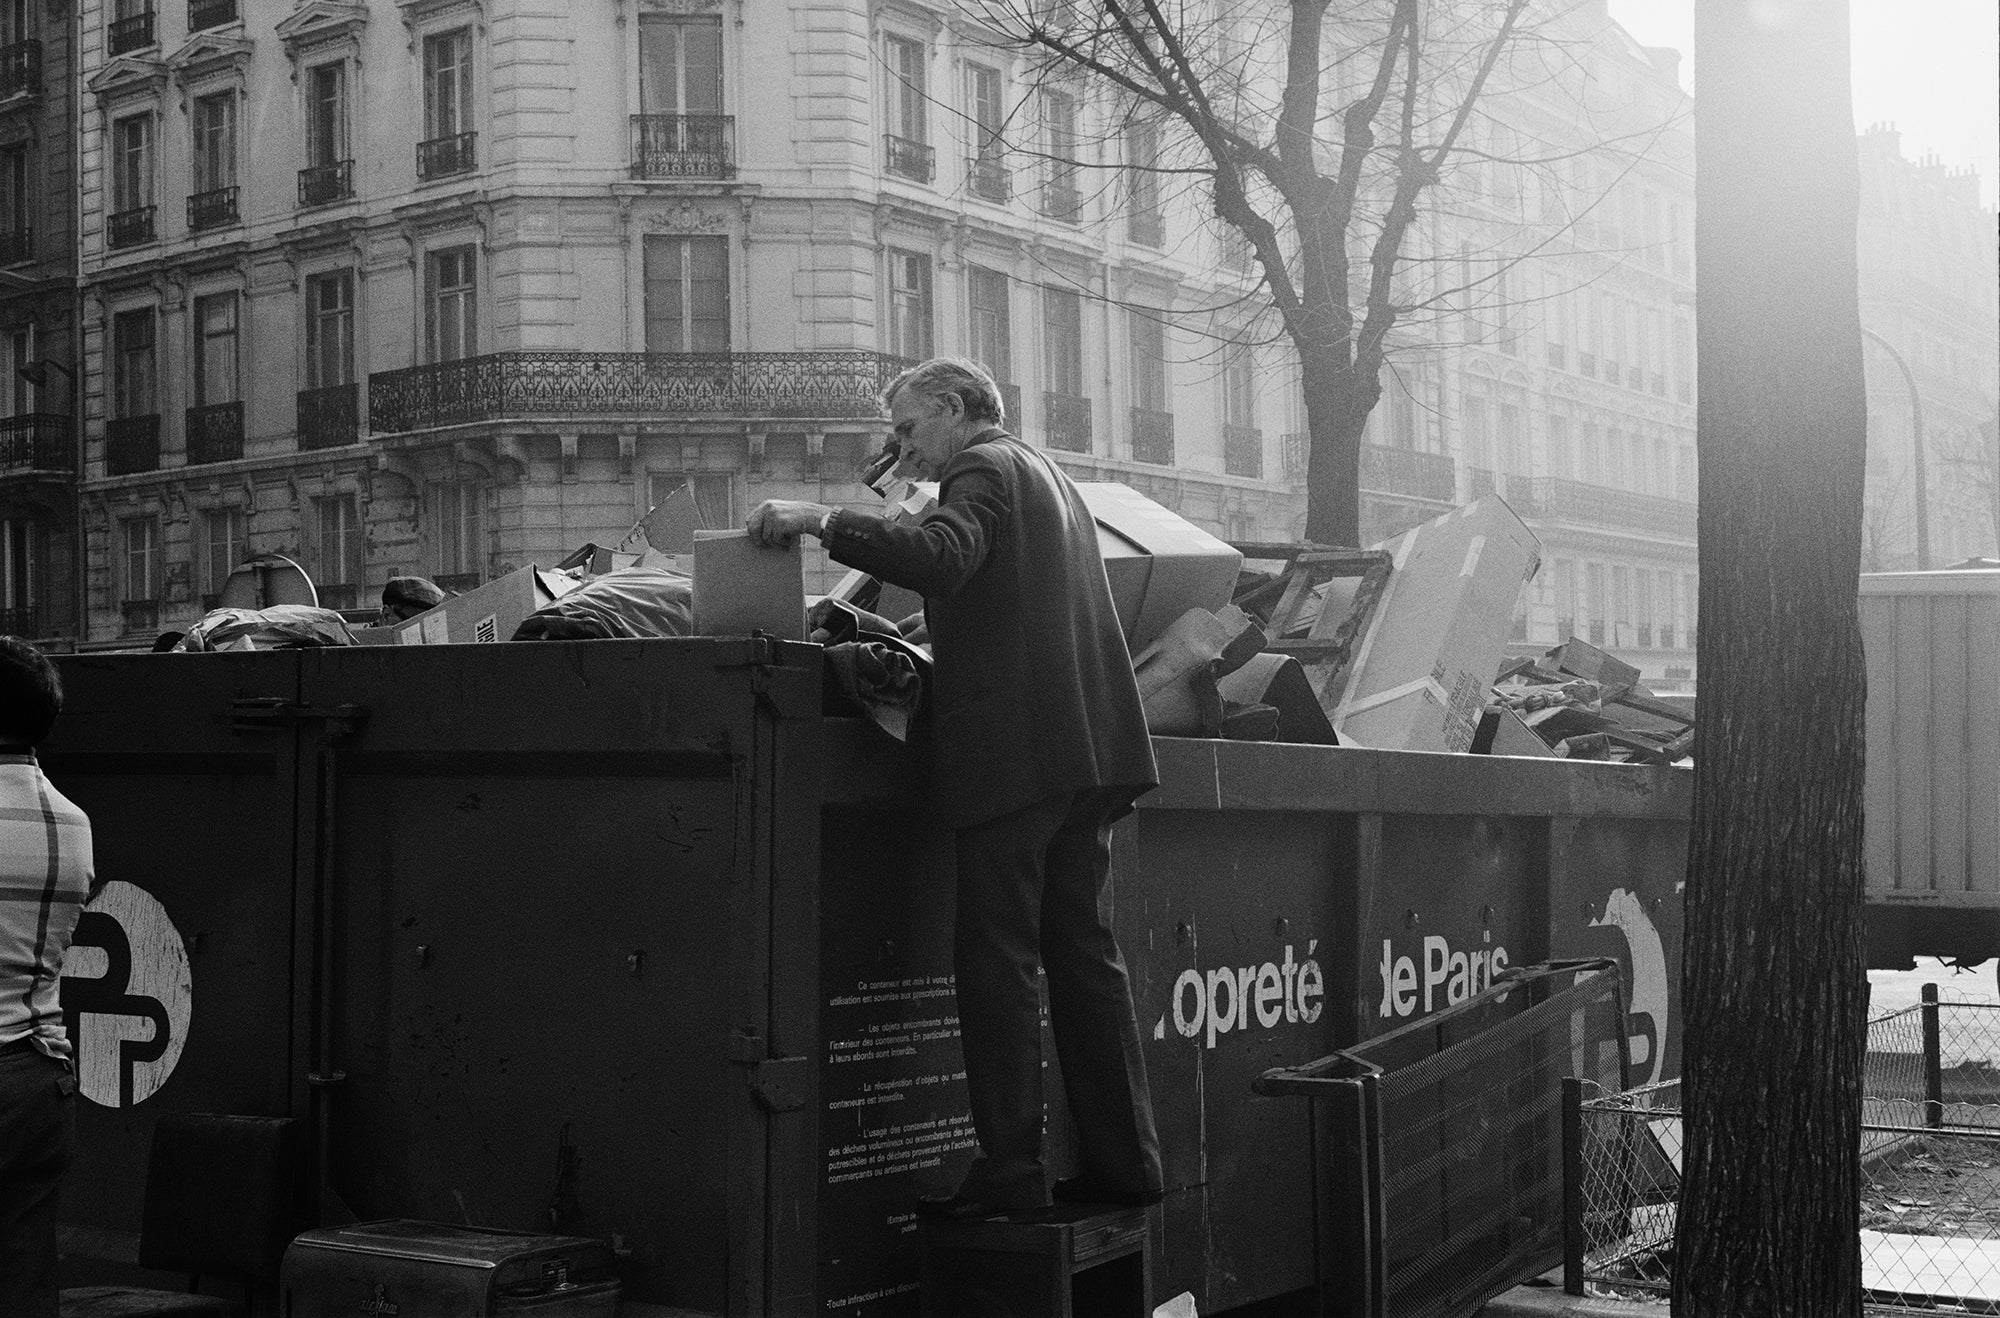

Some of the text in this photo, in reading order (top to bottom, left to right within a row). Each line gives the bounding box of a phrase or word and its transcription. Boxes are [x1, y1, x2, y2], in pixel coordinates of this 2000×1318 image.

[477, 618, 495, 643] GILE
[857, 980, 867, 991] Ce
[869, 979, 900, 990] conteneur
[1154, 939, 1324, 1049] opreté
[1424, 930, 1509, 1013] Paris
[829, 995, 861, 1007] utilisation
[862, 995, 872, 1004] est
[873, 992, 899, 1003] soumise
[900, 992, 911, 1001] aux
[912, 987, 950, 1001] prescriptions
[868, 1023, 880, 1033] Les
[881, 1021, 901, 1033] objets
[902, 1018, 941, 1030] encombrants
[861, 1037, 874, 1047] des
[912, 1032, 921, 1042] En
[922, 1029, 952, 1042] particulier
[829, 1054, 834, 1064] à
[835, 1053, 851, 1063] leurs
[852, 1049, 875, 1062] abords
[875, 1049, 890, 1059] sont
[863, 1082, 872, 1092] La
[874, 1078, 913, 1091] récupération
[915, 1075, 939, 1086] d'objets
[829, 1097, 866, 1110] conteneurs
[866, 1096, 877, 1105] est
[863, 1127, 888, 1139] L'usage
[889, 1125, 901, 1135] des
[903, 1120, 936, 1133] conteneurs
[937, 1118, 948, 1128] est
[828, 1147, 841, 1157] des
[841, 1144, 867, 1156] déchets
[868, 1139, 904, 1152] volumineux
[904, 1137, 914, 1146] ou
[914, 1131, 952, 1144] encombrants
[952, 1127, 964, 1138] des
[828, 1156, 868, 1172] putrescibles
[868, 1155, 876, 1165] et
[876, 1153, 886, 1163] de
[886, 1150, 911, 1162] déchets
[911, 1144, 942, 1159] provenant
[942, 1142, 950, 1152] de
[828, 1169, 874, 1185] commerçants
[874, 1168, 883, 1177] ou
[883, 1163, 909, 1175] artisans
[909, 1161, 919, 1171] est
[847, 1290, 879, 1305] infraction
[884, 1287, 896, 1297] ces
